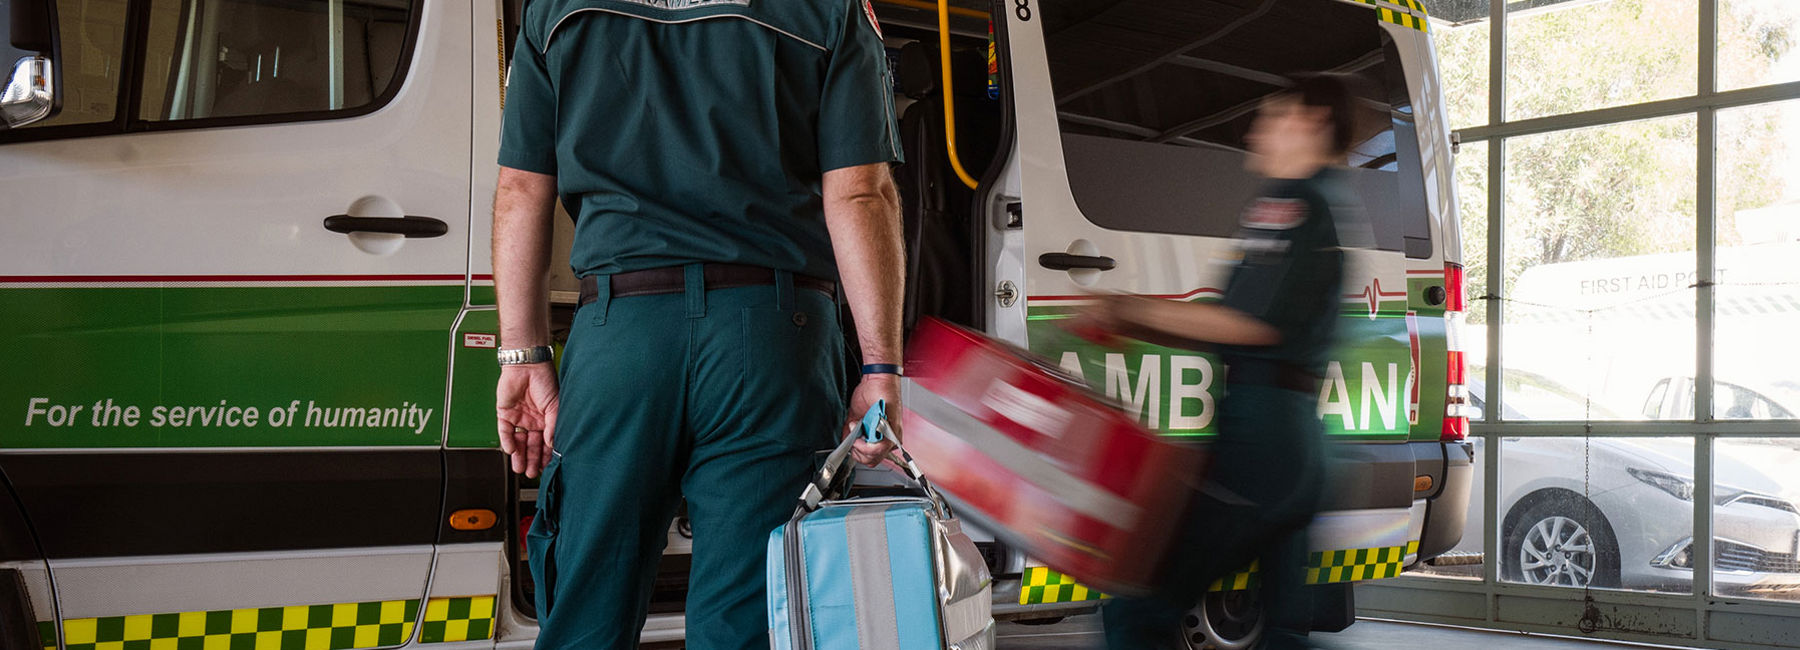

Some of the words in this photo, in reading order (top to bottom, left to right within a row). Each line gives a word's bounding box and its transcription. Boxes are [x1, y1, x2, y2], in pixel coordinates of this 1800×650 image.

[1580, 276, 1632, 295] FIRST
[1638, 274, 1669, 290] AID
[1675, 268, 1727, 288] POT
[1057, 351, 1410, 431] MBAN
[25, 397, 83, 427] For
[91, 398, 141, 427] the
[149, 399, 260, 428] service
[267, 400, 301, 428] of
[304, 401, 433, 434] humanity
